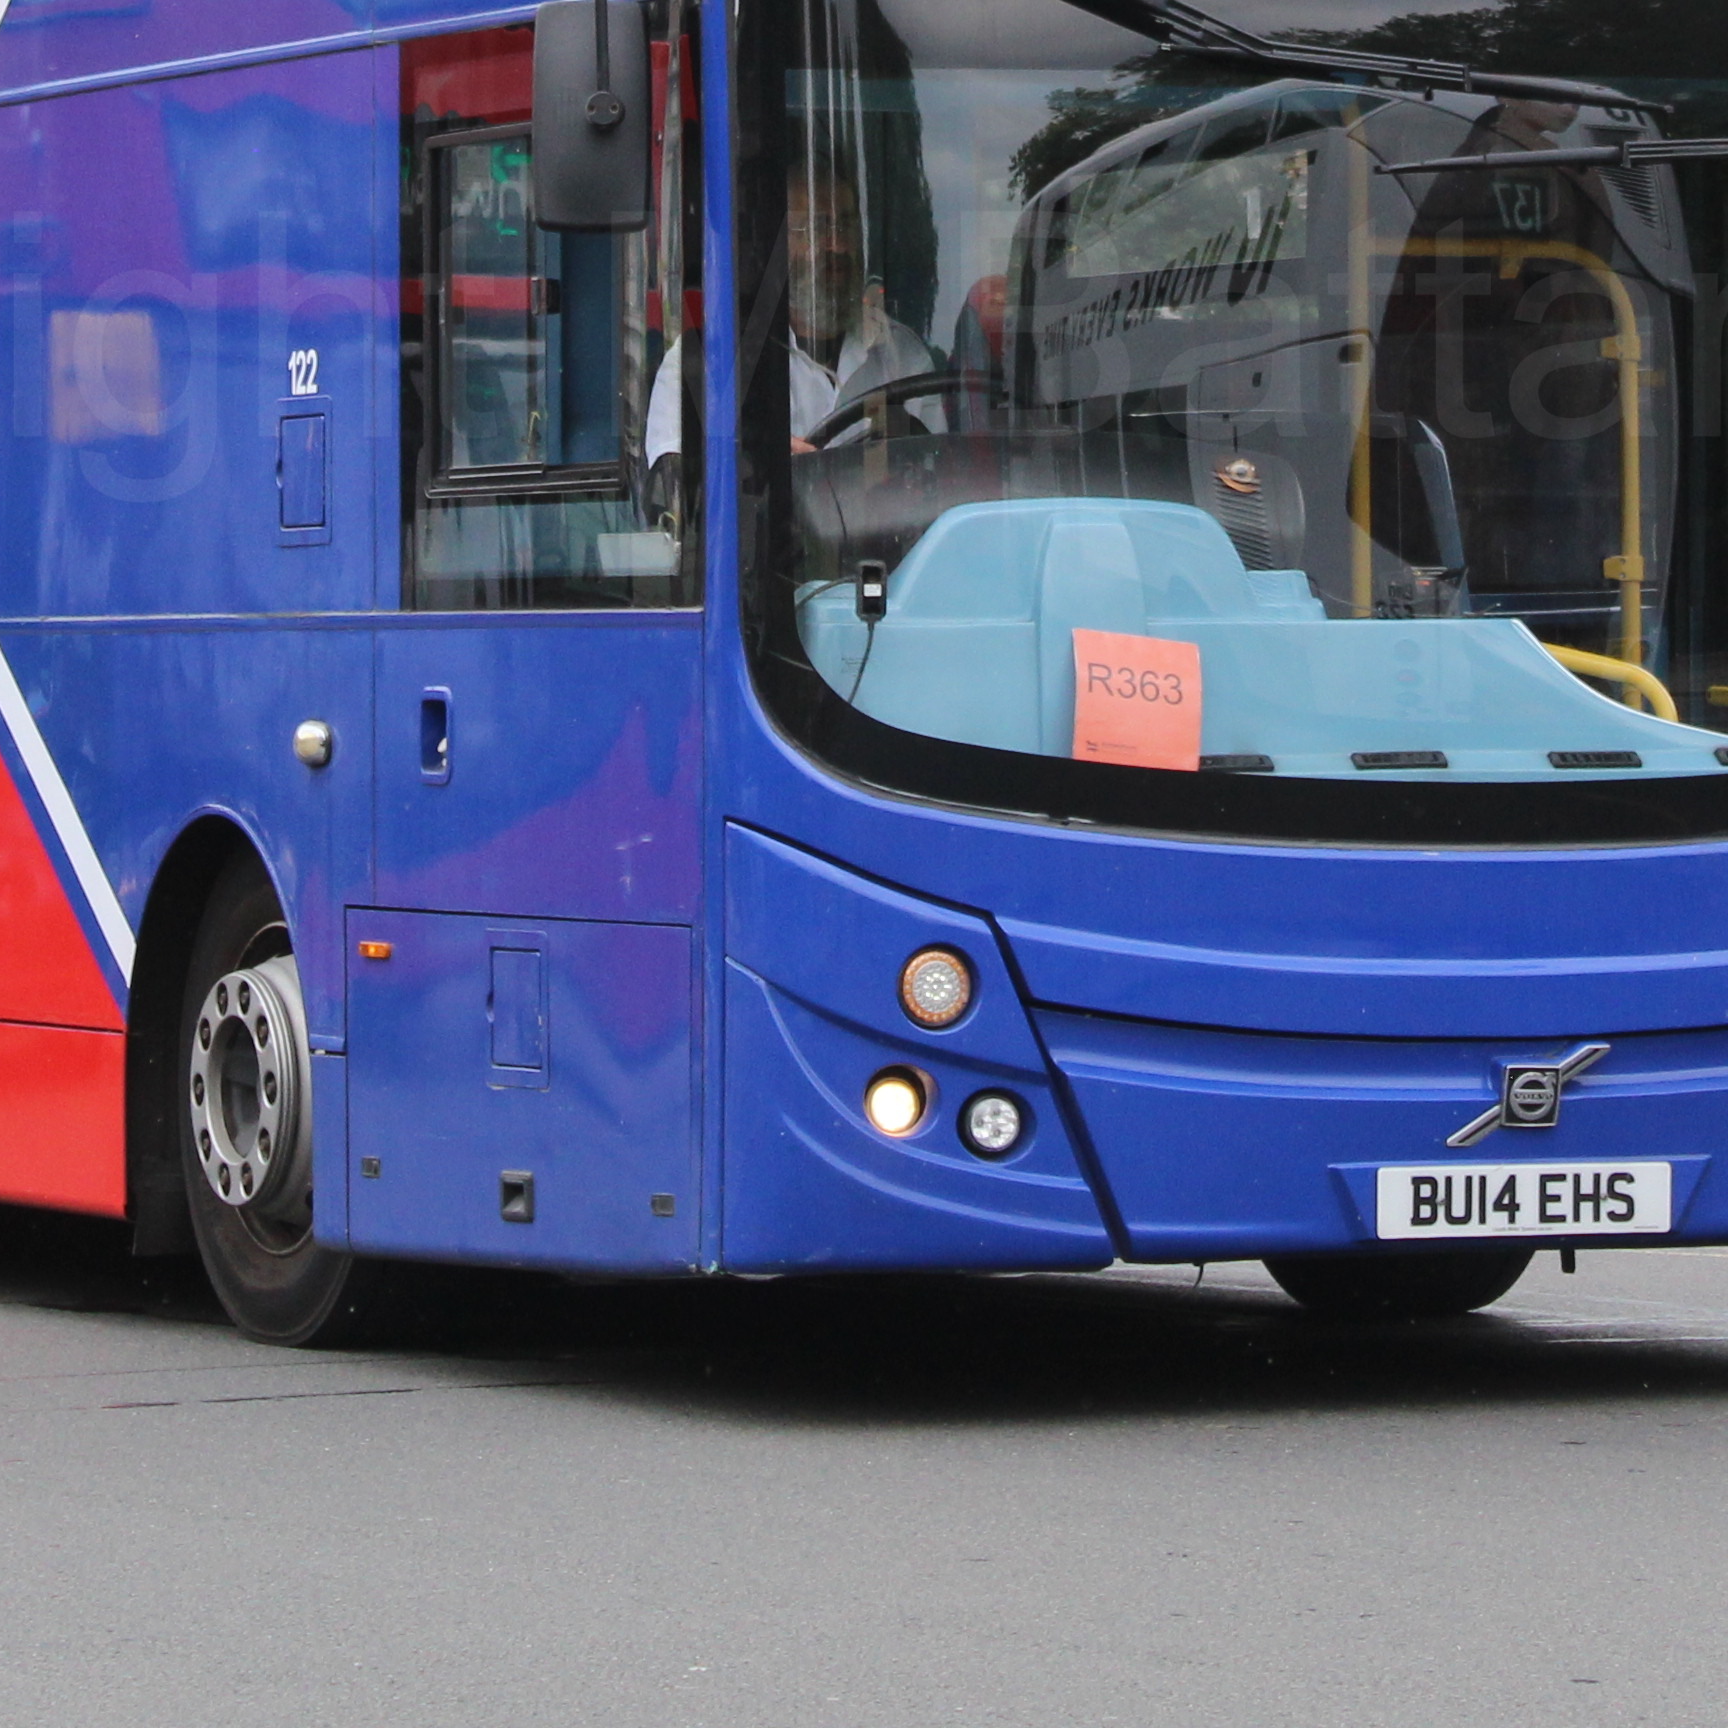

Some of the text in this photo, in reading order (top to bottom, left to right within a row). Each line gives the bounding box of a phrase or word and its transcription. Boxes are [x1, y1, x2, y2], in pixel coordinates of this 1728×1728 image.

[288, 348, 318, 395] 122
[1087, 662, 1183, 705] R363
[1513, 1092, 1553, 1102] VOLVO
[1410, 1171, 1636, 1226] BU14 EHS
